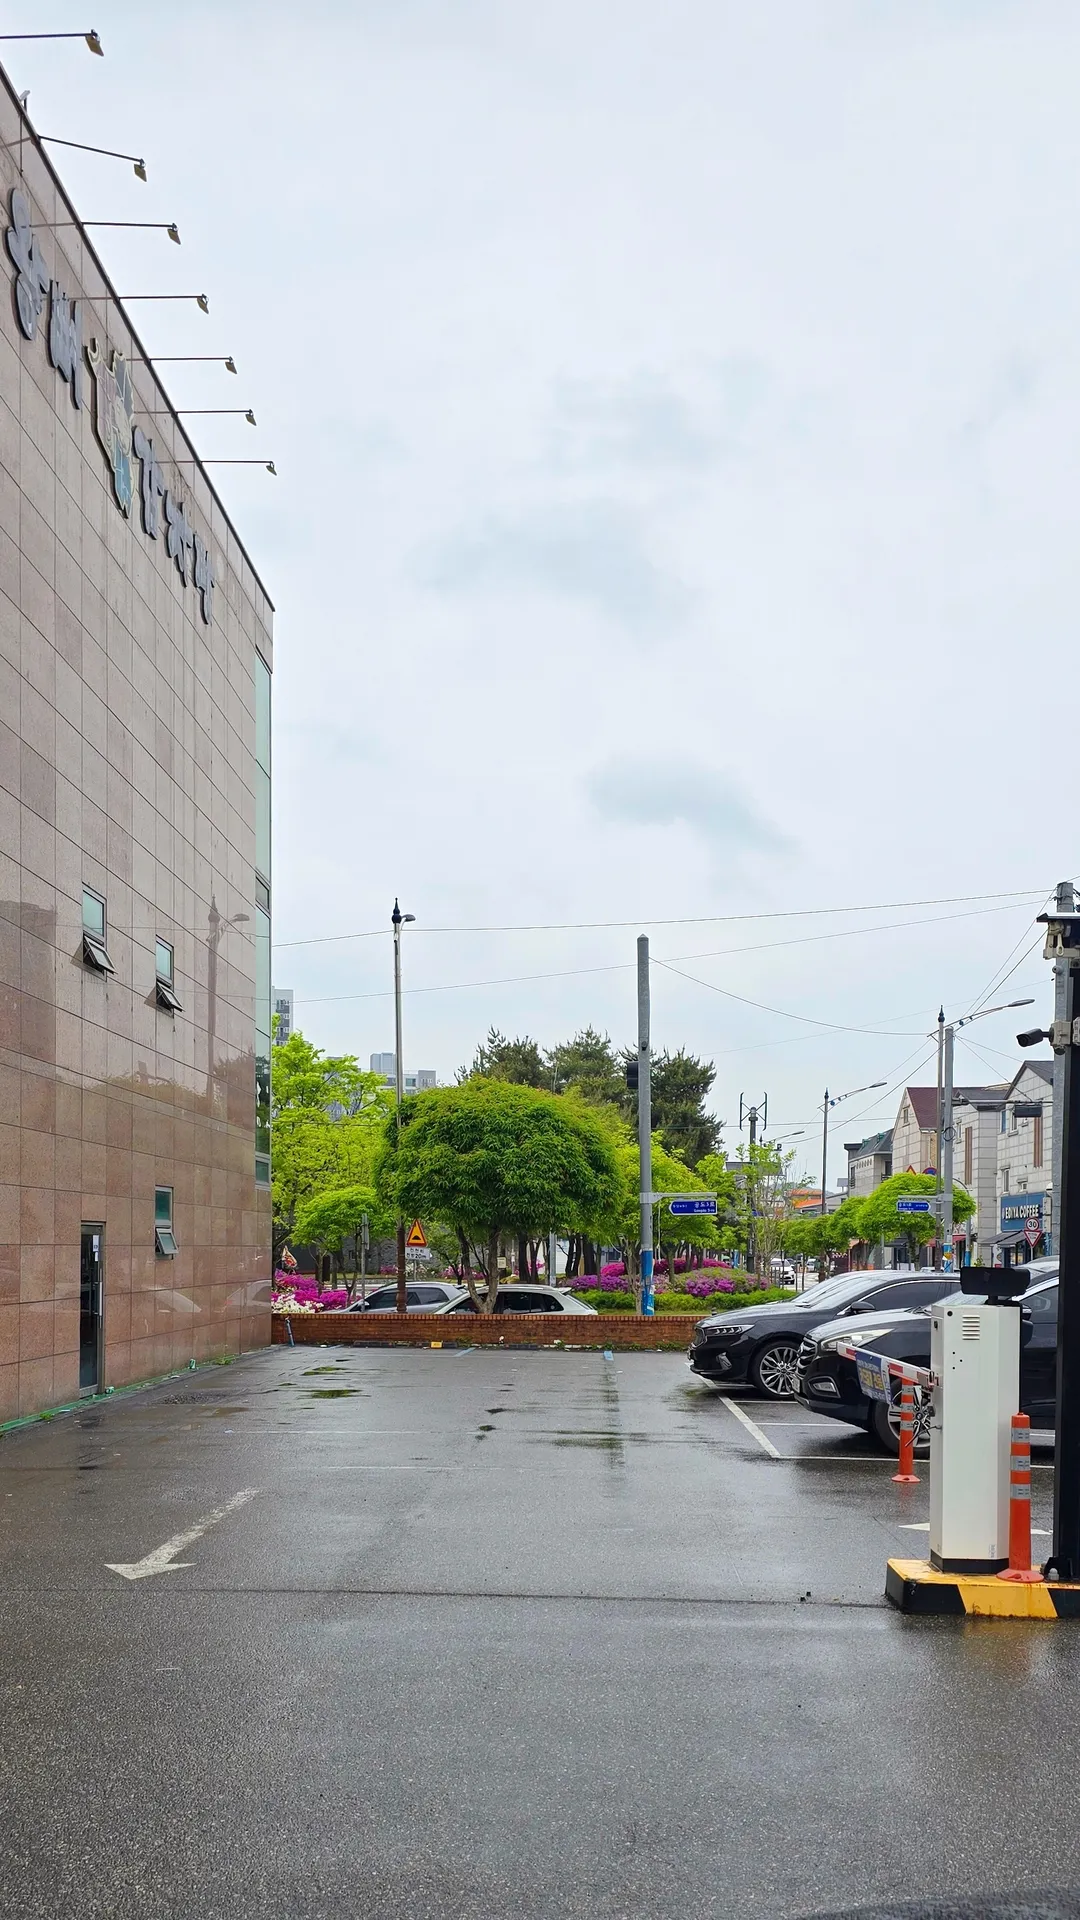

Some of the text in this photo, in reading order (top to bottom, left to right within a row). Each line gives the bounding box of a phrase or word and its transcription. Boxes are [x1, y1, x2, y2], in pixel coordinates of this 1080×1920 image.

[133, 426, 215, 625] 감자탕
[1005, 1204, 1039, 1219] EDIYA COFFEE
